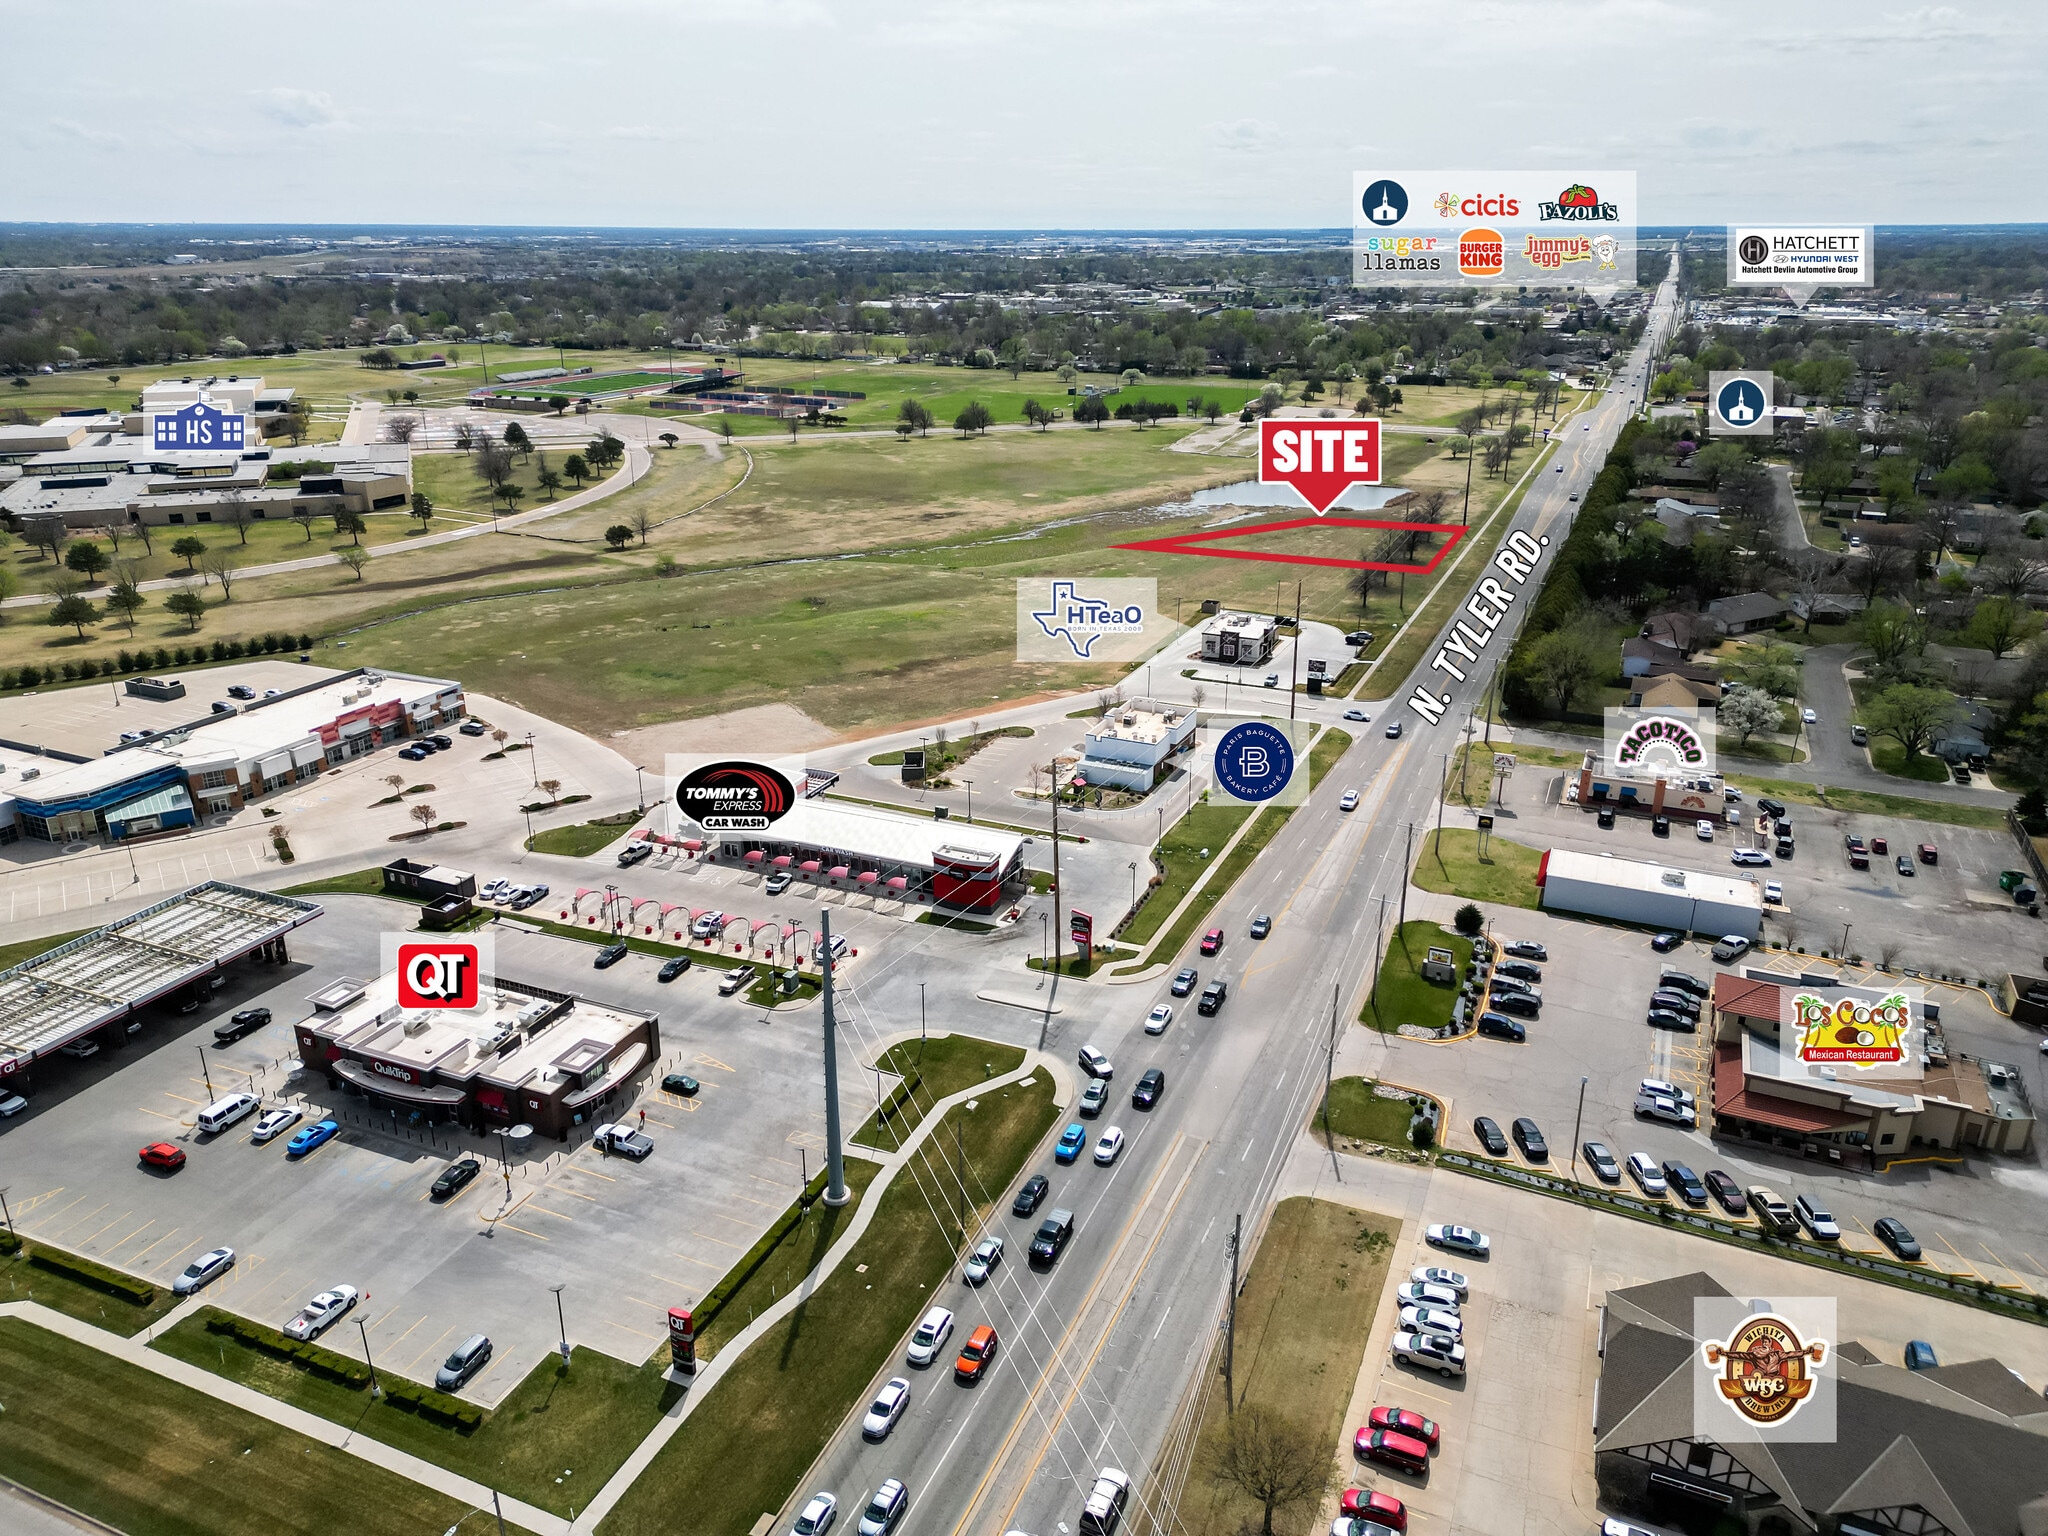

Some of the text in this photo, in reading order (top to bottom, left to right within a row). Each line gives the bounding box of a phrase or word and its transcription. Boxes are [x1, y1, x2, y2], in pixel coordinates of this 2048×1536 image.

[303, 1037, 312, 1046] QT
[374, 1061, 412, 1082] QuikTrip
[529, 1100, 539, 1109] QT
[670, 1316, 685, 1330] QT
